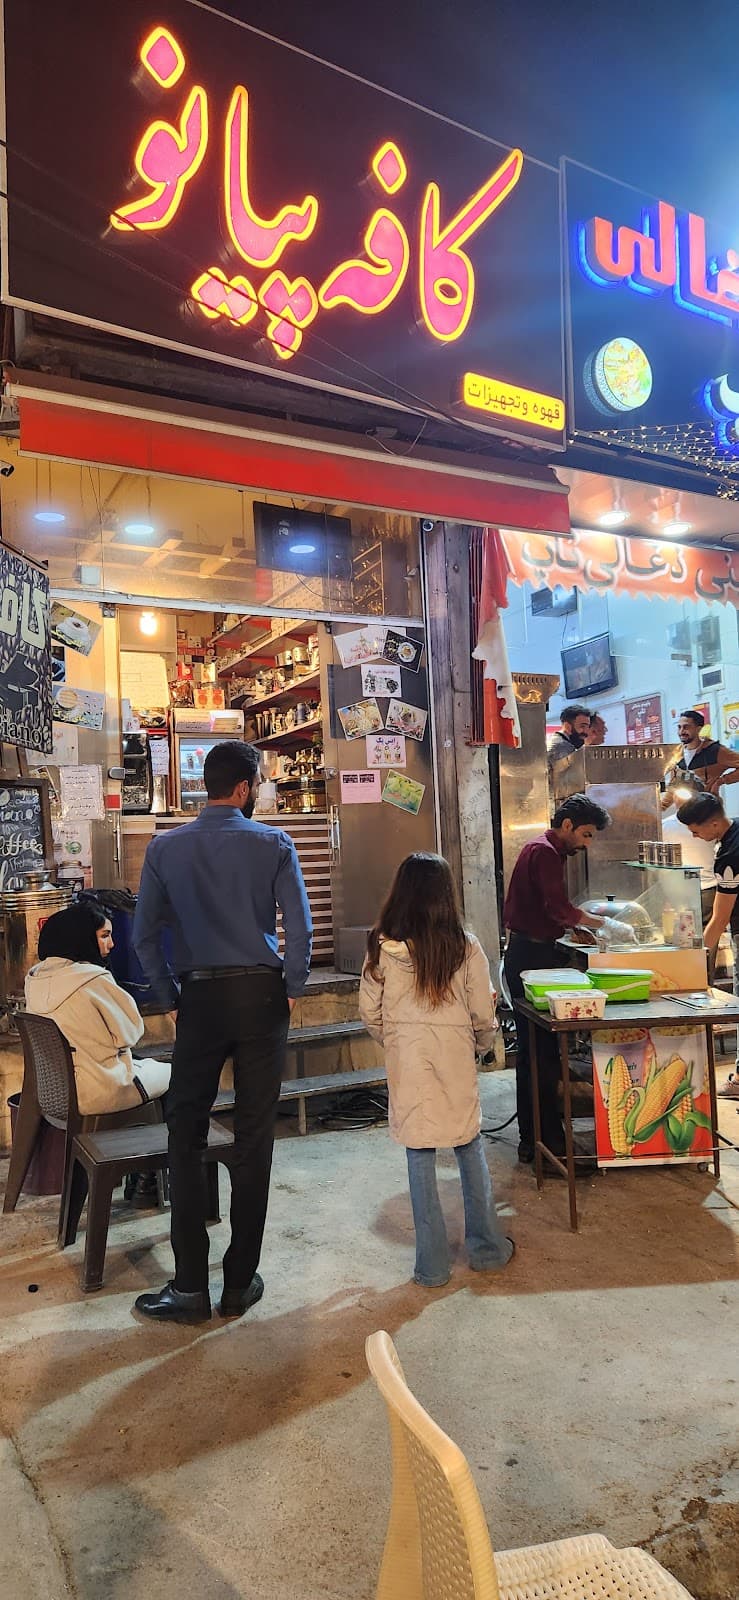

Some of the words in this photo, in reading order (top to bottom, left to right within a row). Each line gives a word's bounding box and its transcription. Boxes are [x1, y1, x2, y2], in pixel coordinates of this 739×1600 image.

[109, 25, 319, 361] پیانو
[319, 141, 524, 343] کافه
[532, 402, 560, 423] قهوه
[0, 573, 46, 650] کاف
[0, 716, 42, 745] iano
[0, 806, 34, 822] iano
